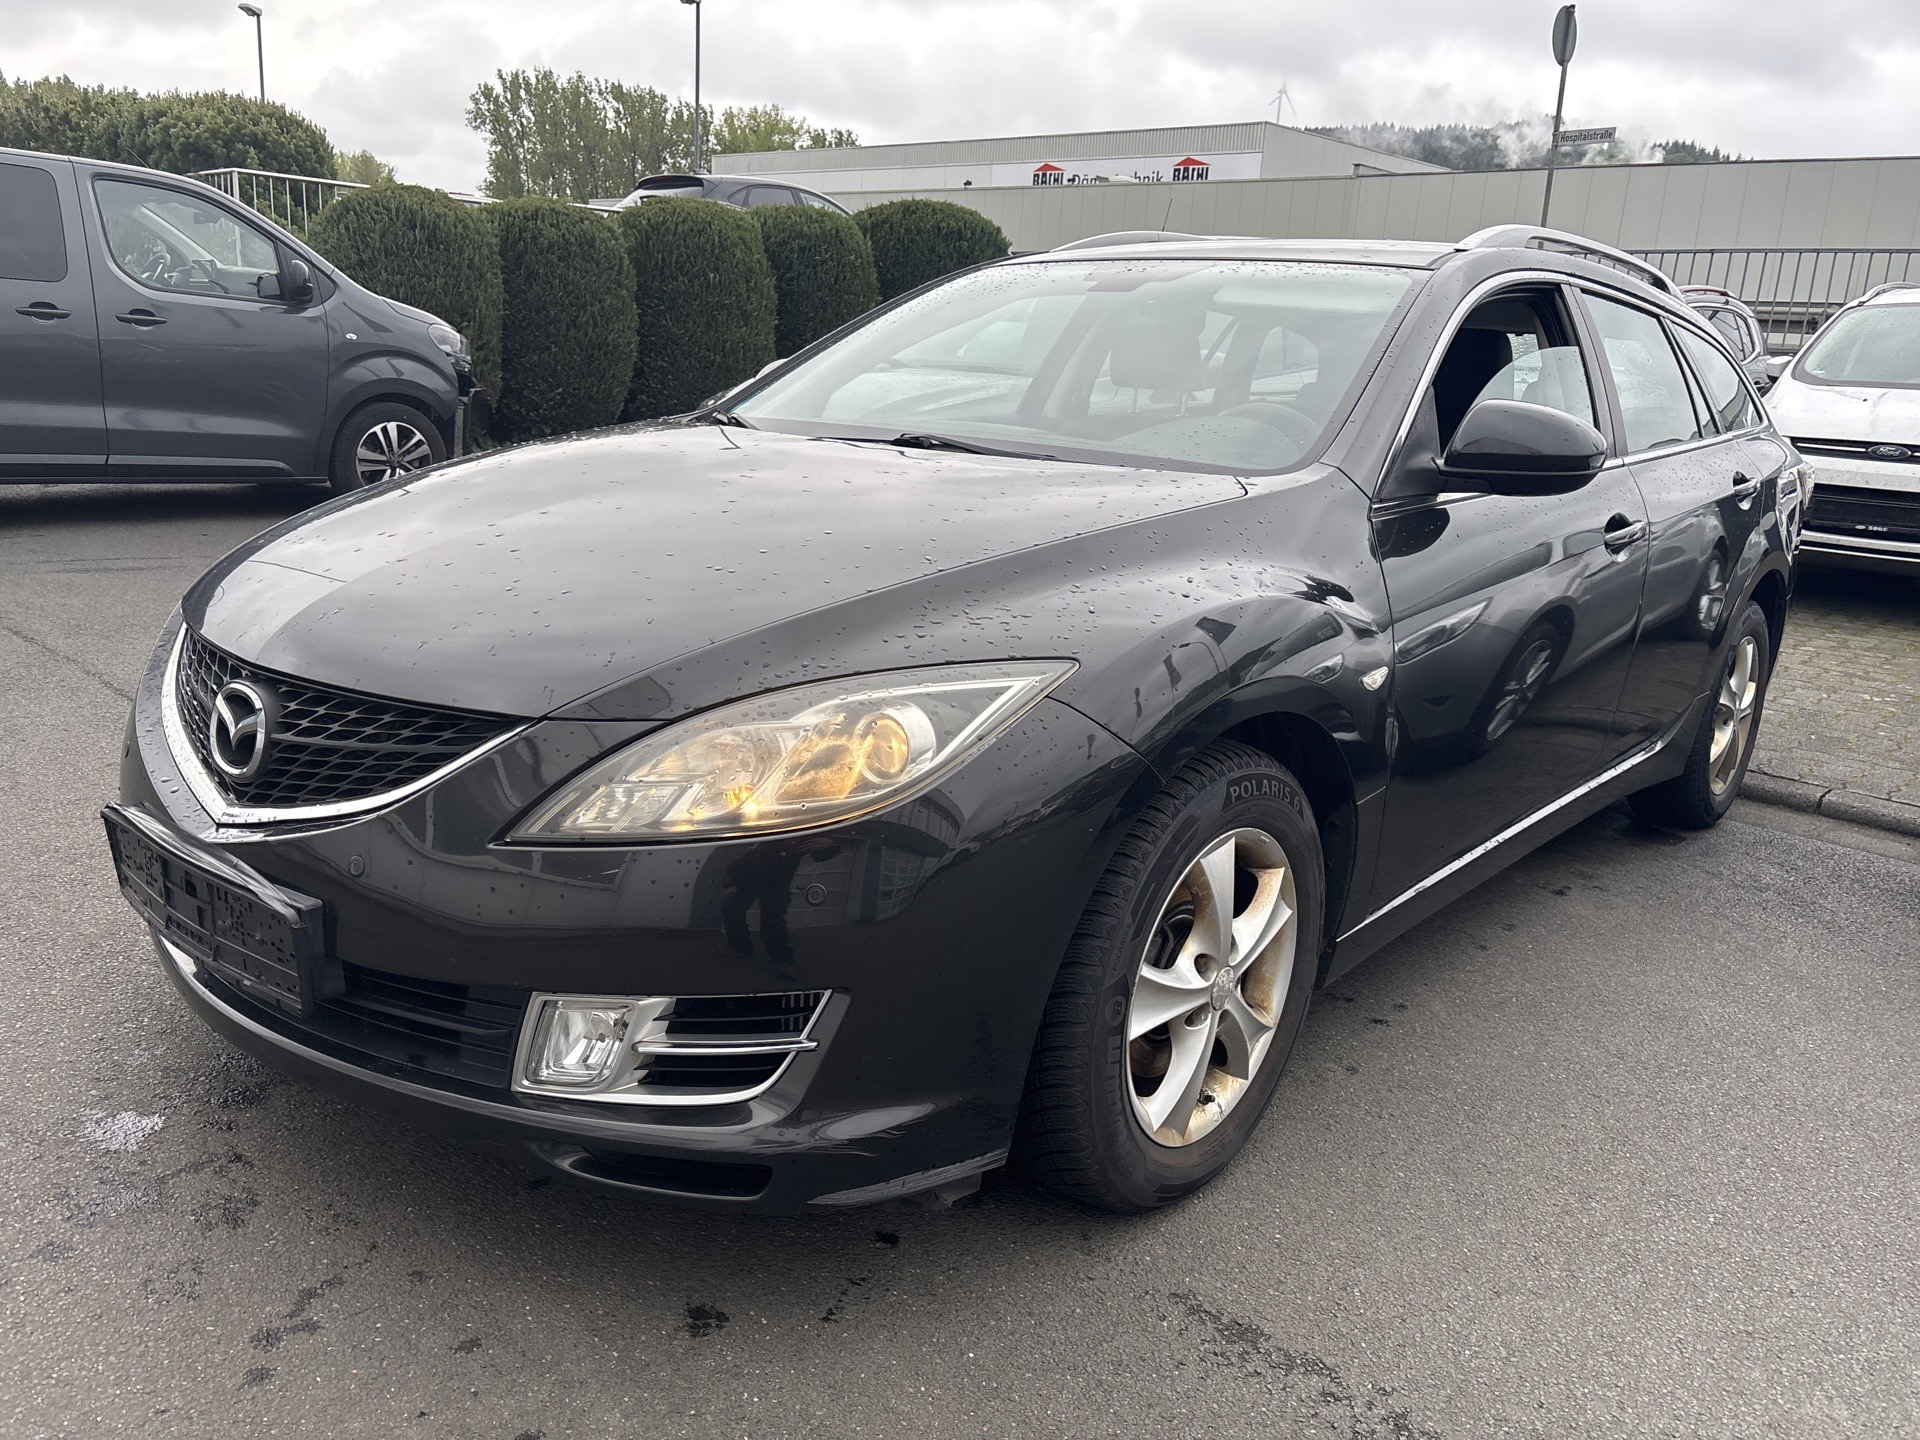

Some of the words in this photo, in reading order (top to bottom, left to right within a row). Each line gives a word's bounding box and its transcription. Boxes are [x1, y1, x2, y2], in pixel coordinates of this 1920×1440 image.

[1560, 130, 1613, 144] Hospitalstraße
[1229, 779, 1291, 804] POLARIS
[1293, 796, 1300, 811] 6
[1112, 931, 1129, 972] POLARIS
